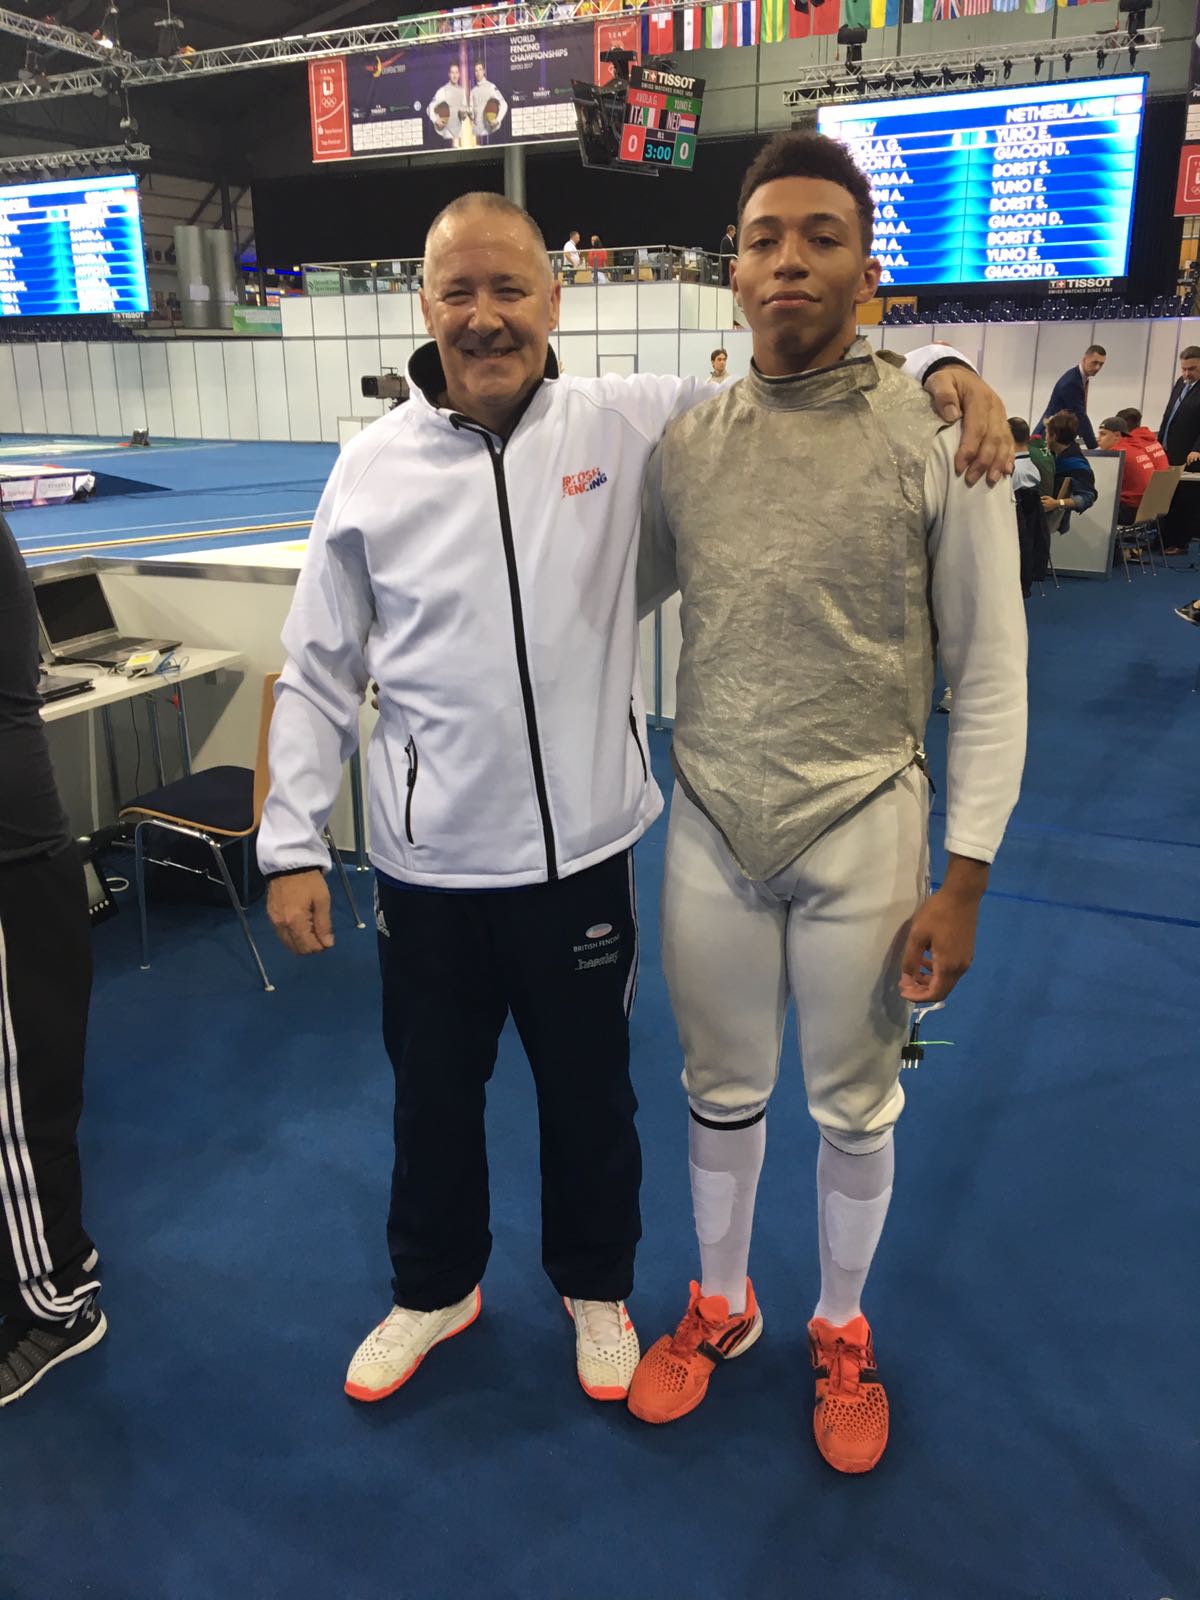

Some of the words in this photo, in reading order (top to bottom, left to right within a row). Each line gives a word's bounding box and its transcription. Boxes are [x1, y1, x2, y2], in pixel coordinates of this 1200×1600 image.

[510, 34, 536, 45] WORLD
[510, 42, 540, 54] FENCING
[510, 48, 568, 63] CHAMPIONSHIPS
[657, 71, 696, 90] TISSOT
[630, 105, 644, 125] ITA
[995, 126, 1036, 143] YUNO
[1038, 124, 1051, 139] E.
[628, 134, 638, 153] 0
[645, 143, 672, 161] 3:00
[679, 142, 689, 160] 0
[993, 143, 1053, 161] GIACON
[1055, 141, 1070, 155] D.
[992, 161, 1038, 178] BORST
[1038, 160, 1051, 174] S.
[991, 179, 1032, 195] YUNO
[1033, 178, 1047, 192] E.
[990, 195, 1035, 212] BORST
[1035, 194, 1049, 209] S.
[988, 212, 1047, 229] GIACON
[1048, 211, 1064, 226] D.
[986, 230, 1032, 247] BORST
[1032, 230, 1046, 244] S.
[986, 247, 1027, 262] YUNO
[1027, 246, 1041, 261] E.
[984, 264, 1043, 279] GIACON
[1043, 262, 1060, 277] D.
[1066, 277, 1114, 288] TISSOT
[573, 942, 598, 952] BRITISH
